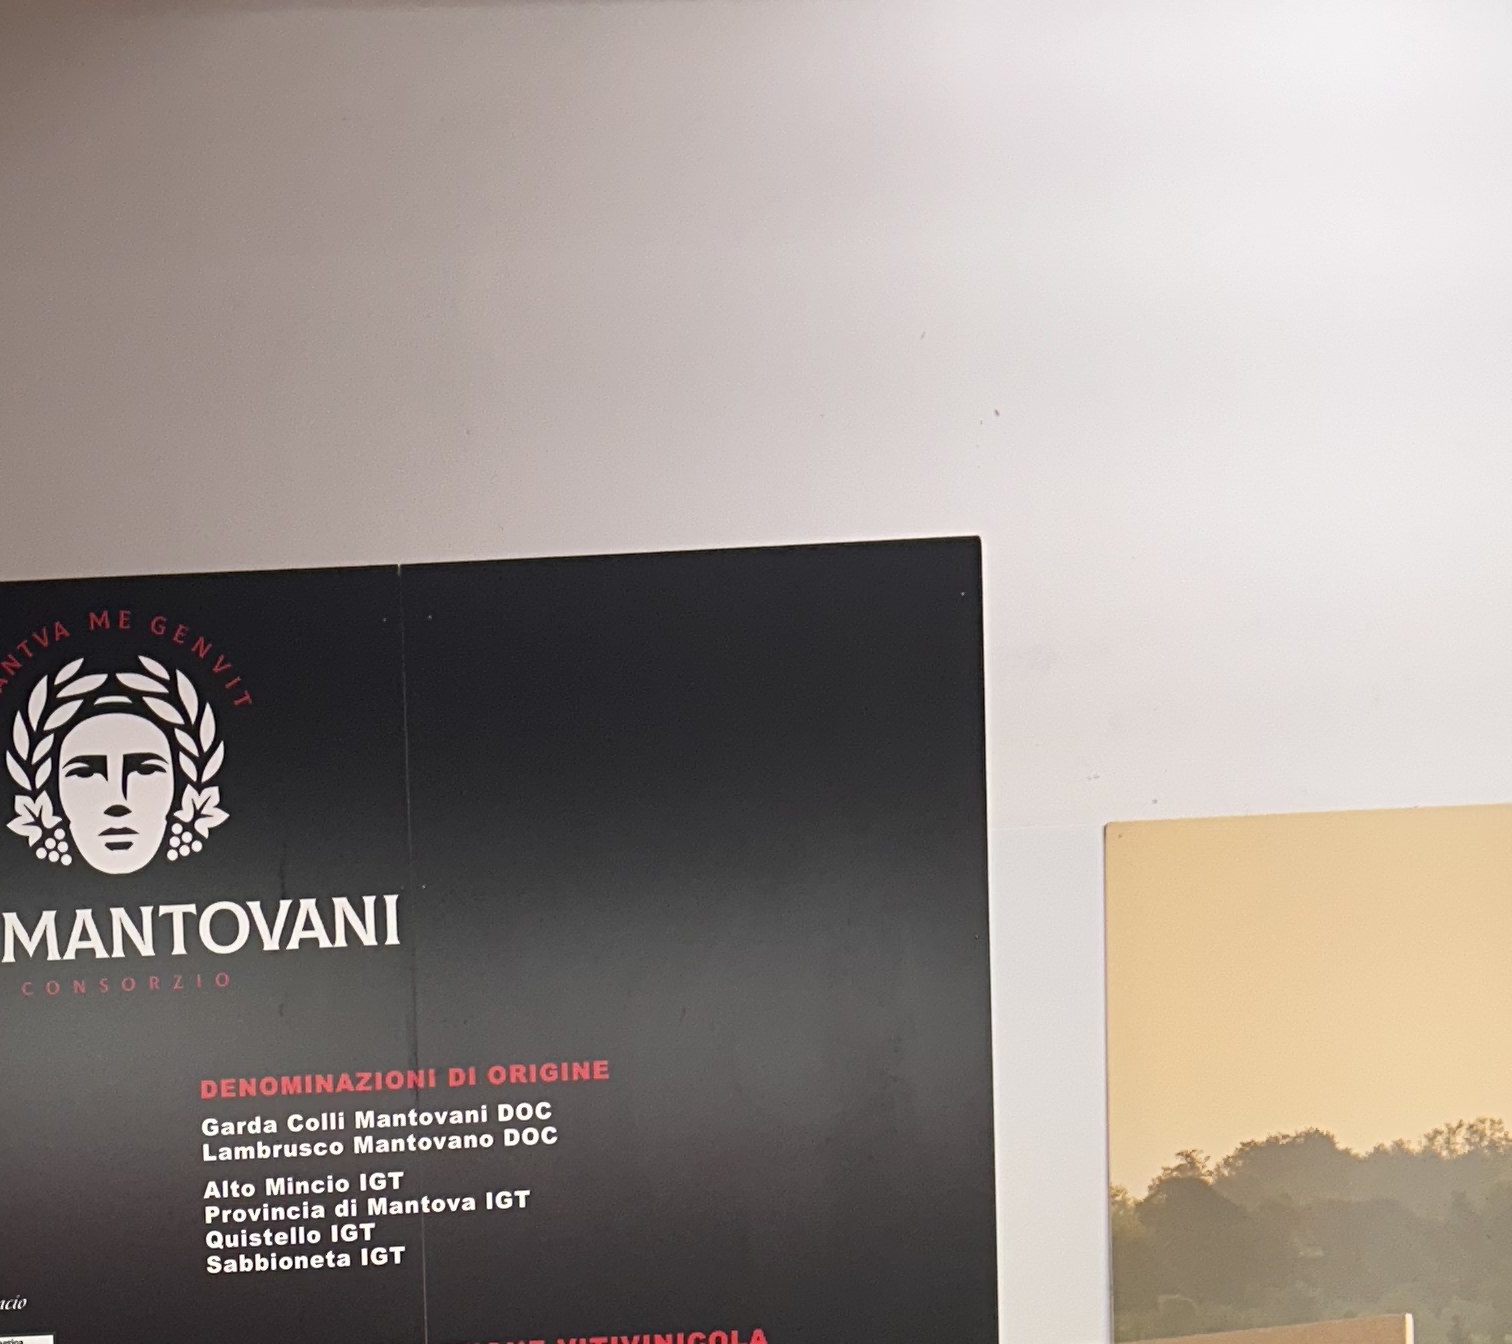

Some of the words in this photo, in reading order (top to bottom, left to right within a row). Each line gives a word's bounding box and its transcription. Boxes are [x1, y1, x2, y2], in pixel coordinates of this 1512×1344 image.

[90, 610, 132, 631] ME
[150, 615, 253, 709] GENVIT
[1, 894, 401, 964] MANTOVANI
[21, 972, 231, 997] CONSORZIO
[199, 1067, 437, 1100] DENOMINAZIONI
[448, 1066, 478, 1088] DI
[488, 1060, 610, 1086] ORIGINE
[201, 1114, 278, 1137] Garda
[287, 1109, 346, 1133] Colli
[354, 1104, 489, 1129] Mantovani
[497, 1101, 553, 1123] DOC
[202, 1137, 344, 1163] Lambrusco
[353, 1130, 494, 1155] Mantovano
[503, 1126, 559, 1148] DOC
[203, 1178, 255, 1200] Alto
[265, 1174, 350, 1197] Mincio
[360, 1172, 404, 1192] IGT
[204, 1200, 327, 1225] Provincia
[334, 1199, 358, 1219] di
[367, 1193, 476, 1217] Mantova
[486, 1190, 531, 1210] IGT
[205, 1226, 321, 1250] Quistello
[331, 1223, 376, 1243] IGT
[206, 1250, 351, 1275] Sabbioneta
[361, 1246, 406, 1266] IGT
